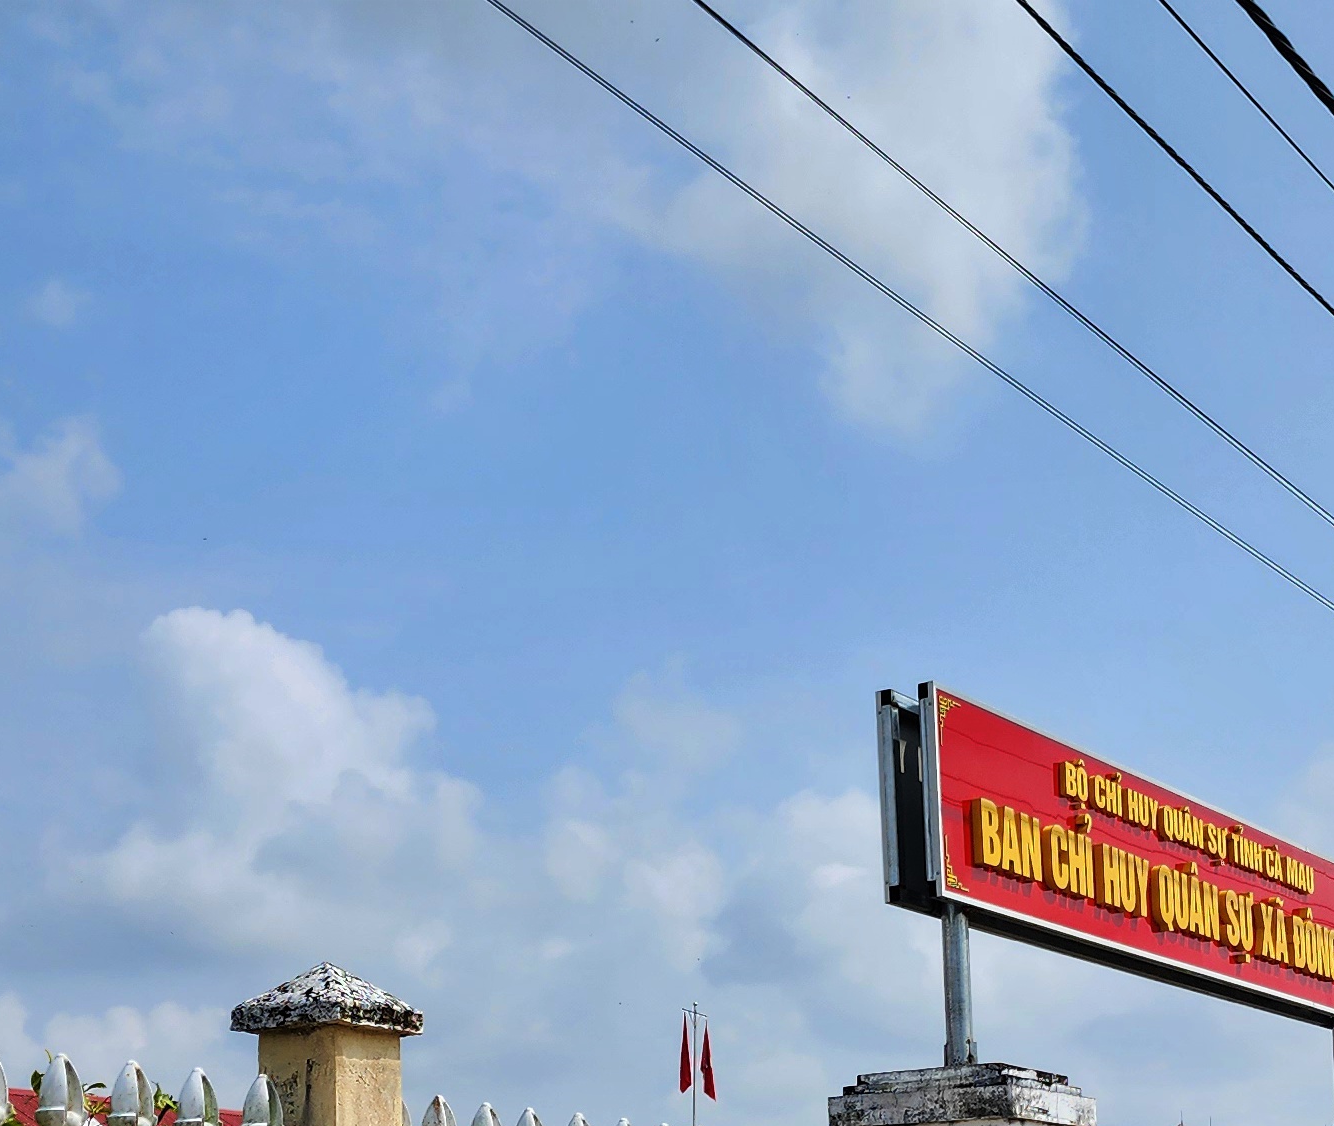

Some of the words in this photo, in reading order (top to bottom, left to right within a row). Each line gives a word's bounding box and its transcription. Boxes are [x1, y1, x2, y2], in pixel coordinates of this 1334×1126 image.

[980, 797, 1043, 883] BAN
[1050, 813, 1095, 900] CHỈ
[1102, 843, 1150, 918] HUY
[1158, 861, 1221, 942] QUÂN
[1226, 889, 1254, 964] SỰ
[1260, 897, 1289, 964] XÃ
[1064, 759, 1089, 810] BỘ
[1094, 771, 1123, 818] CHỈ
[1127, 787, 1159, 831] HUY
[1163, 805, 1205, 850] QUÂN
[1207, 822, 1229, 867] SỰ
[1231, 824, 1264, 873] TỈNH
[1265, 844, 1284, 883] CÀ
[1286, 855, 1316, 895] MAU
